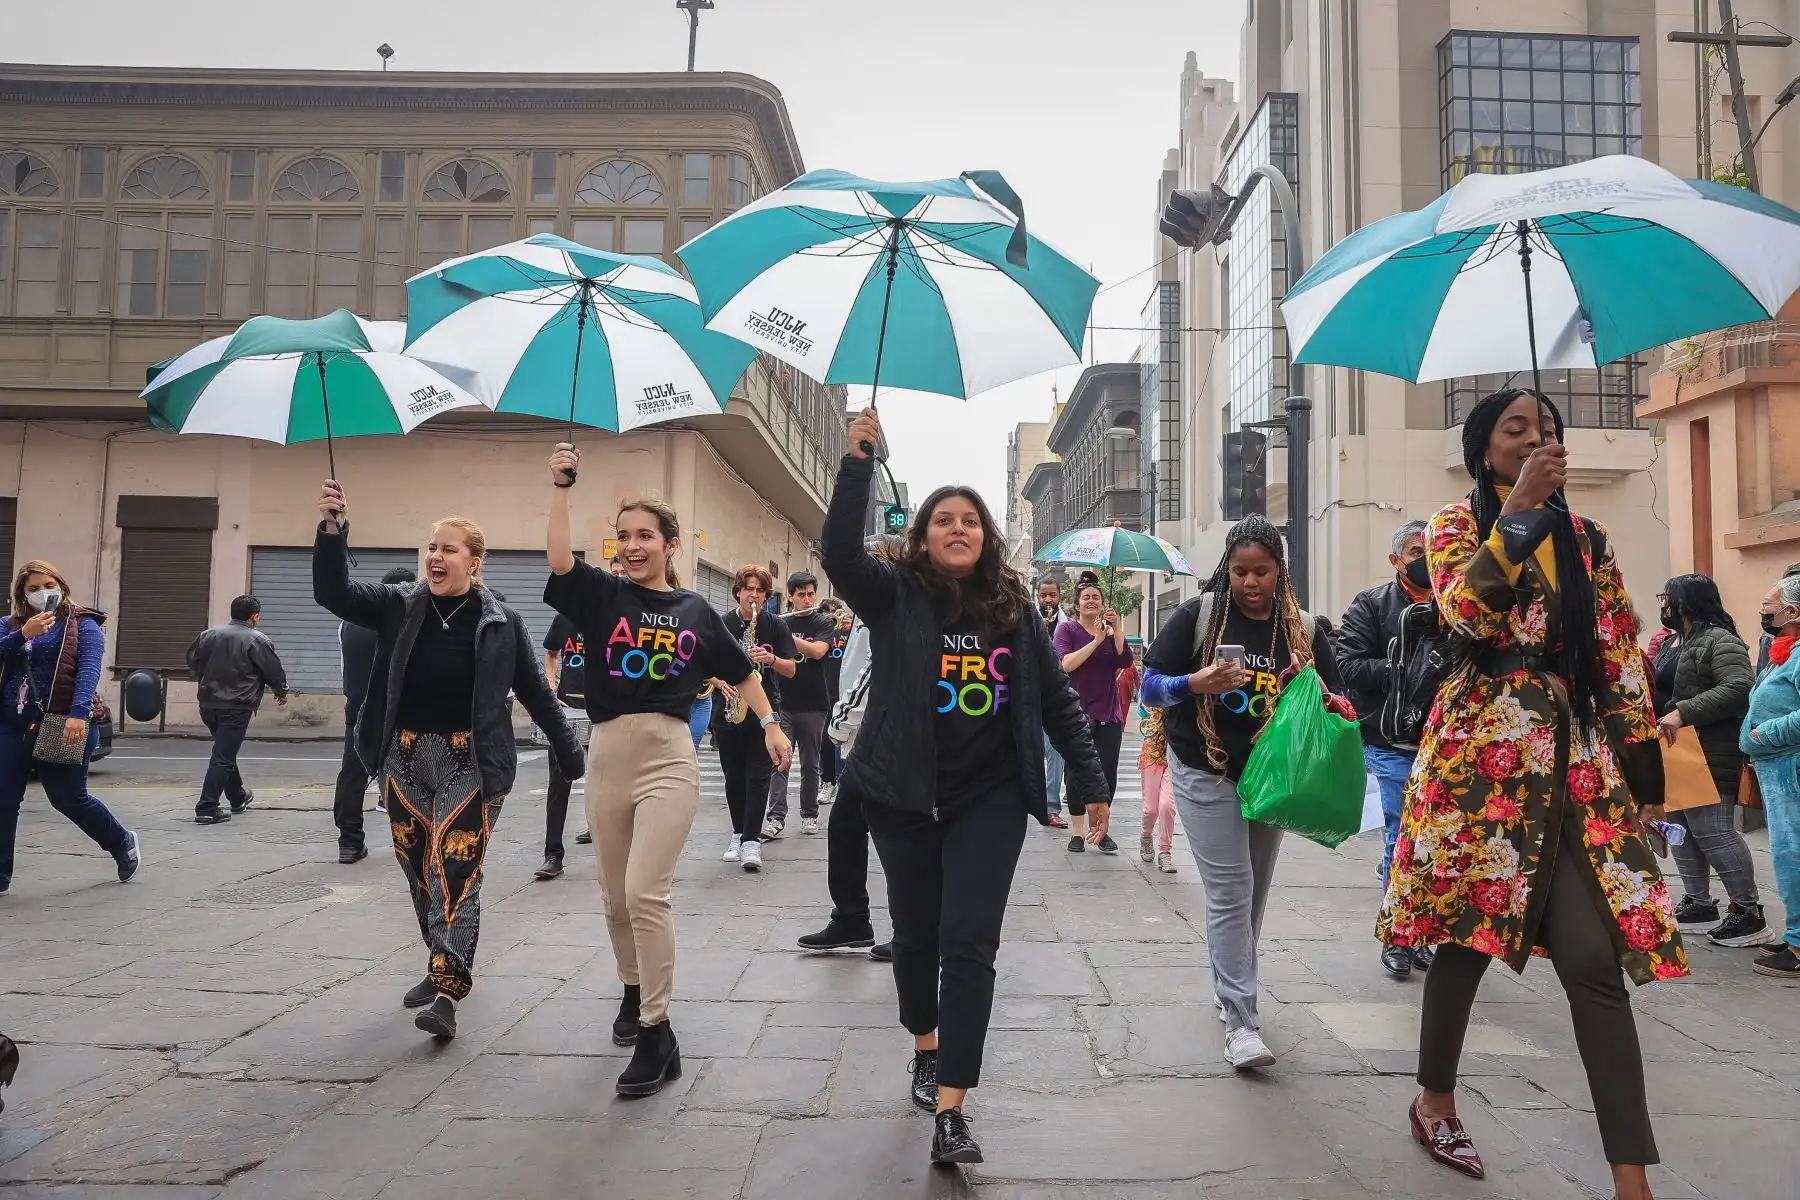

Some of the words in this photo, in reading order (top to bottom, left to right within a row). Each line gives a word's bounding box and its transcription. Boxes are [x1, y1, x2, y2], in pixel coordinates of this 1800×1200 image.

[890, 513, 905, 526] 38
[640, 612, 679, 628] NJCU
[608, 616, 697, 660] AFRO
